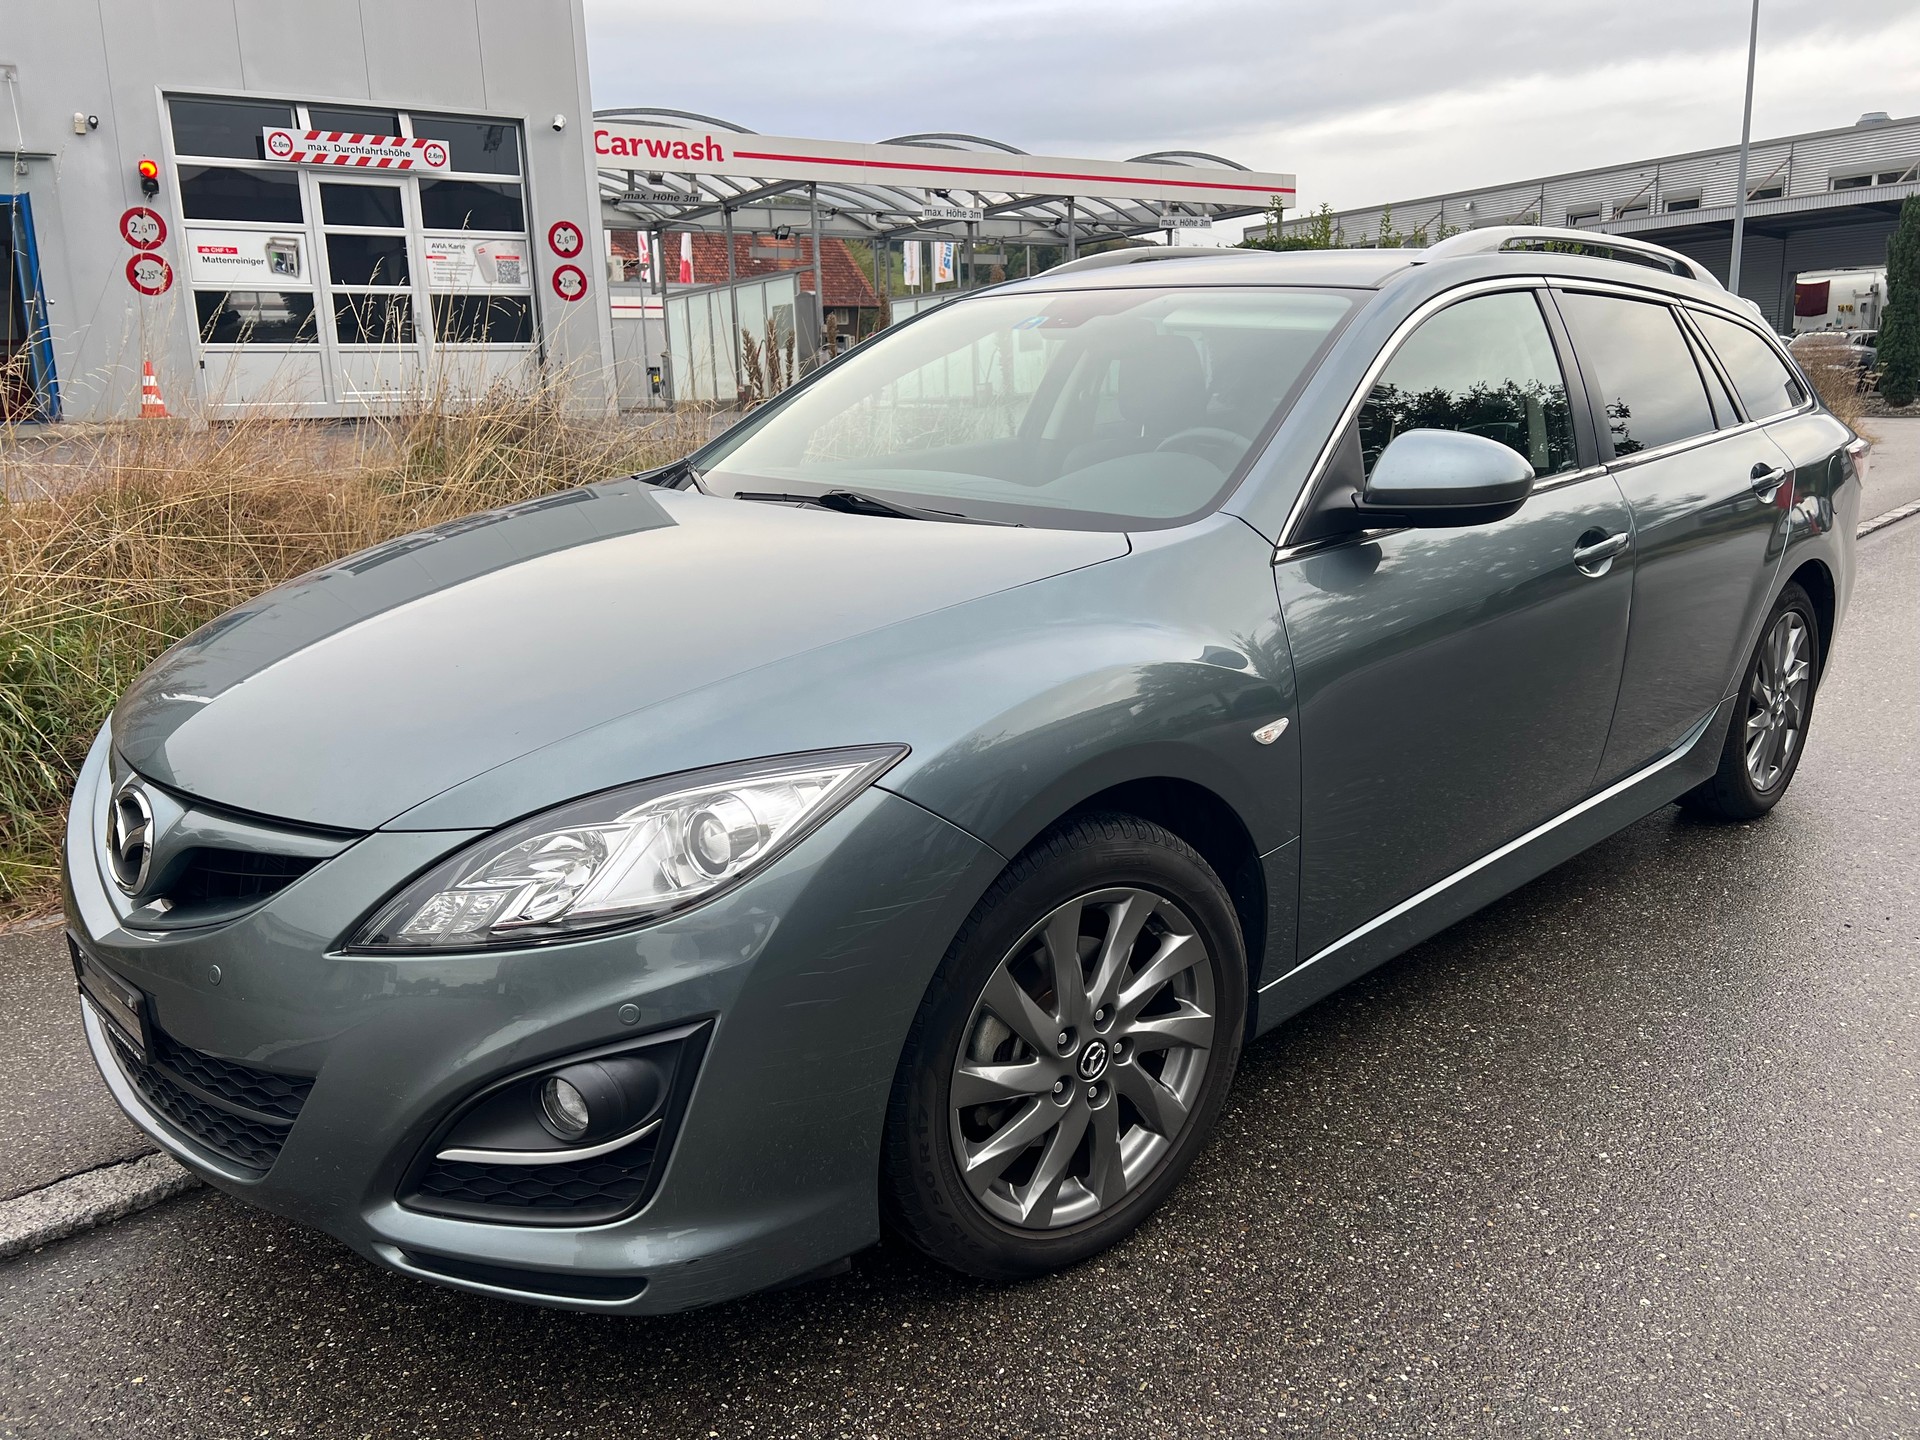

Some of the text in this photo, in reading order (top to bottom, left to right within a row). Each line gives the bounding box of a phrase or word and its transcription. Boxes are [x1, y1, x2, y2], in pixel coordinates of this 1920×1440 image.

[307, 143, 411, 158] max. Durchfahrtshöhe
[594, 130, 724, 162] Carwash
[623, 192, 699, 203] max. Höhe 3m
[924, 208, 982, 219] max. Höhe 3m
[1180, 218, 1198, 227] Höhe
[1199, 219, 1211, 227] 3m
[202, 256, 265, 267] Mattenreiniger
